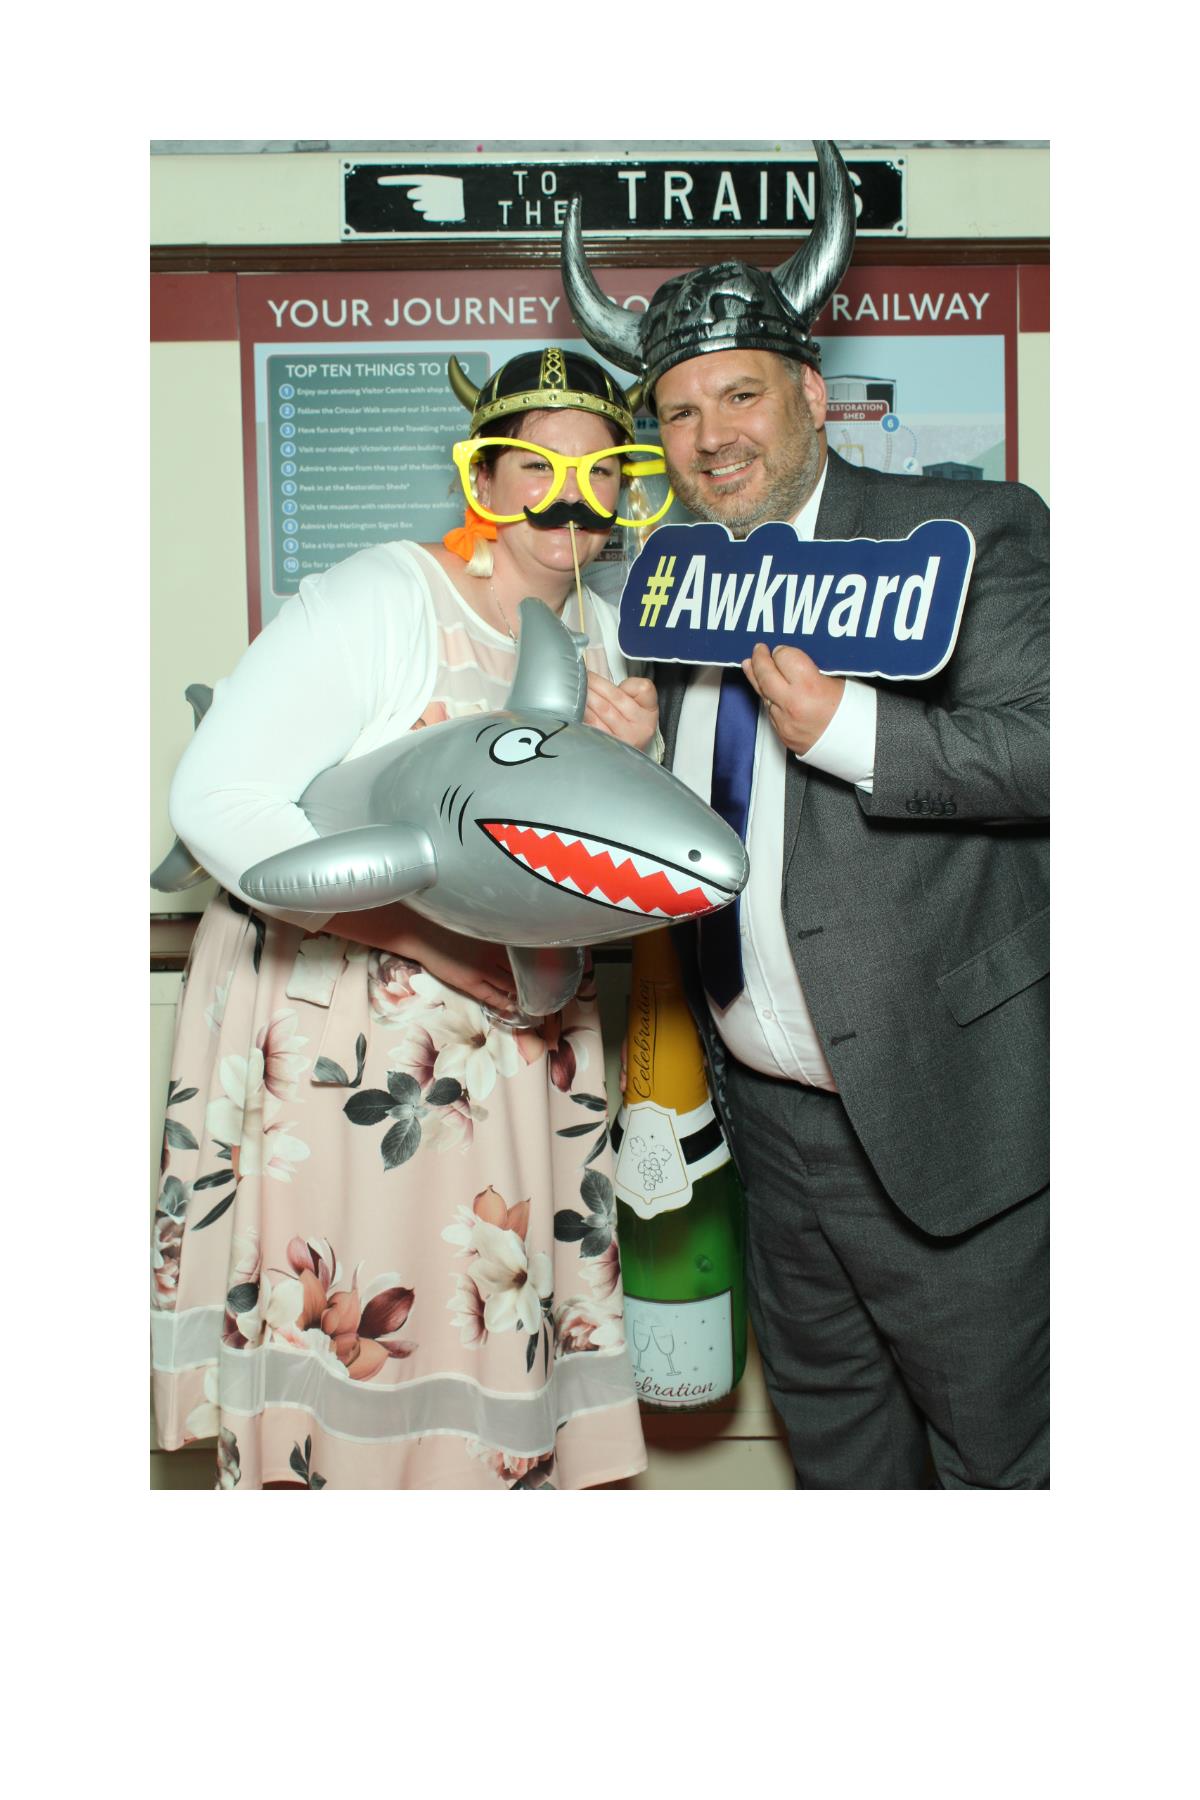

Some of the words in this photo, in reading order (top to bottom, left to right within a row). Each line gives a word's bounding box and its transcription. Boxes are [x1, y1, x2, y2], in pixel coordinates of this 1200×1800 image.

[512, 169, 557, 196] TO
[498, 199, 569, 226] THE
[267, 298, 373, 328] YOUR
[384, 296, 561, 327] JOURNEY
[832, 292, 990, 321] RAILWAY
[285, 364, 318, 378] TOP
[320, 363, 352, 378] TEN
[354, 362, 416, 377] THINGS
[418, 362, 441, 376] TO
[444, 362, 470, 376] O
[297, 388, 316, 396] Enjoy
[330, 388, 360, 396] stunning
[427, 386, 444, 396] shop
[297, 406, 320, 414] Follow
[322, 406, 333, 414] the
[334, 406, 362, 414] Circular
[382, 406, 406, 414] around
[330, 426, 354, 435] sorting
[406, 424, 439, 434] Travelling
[328, 446, 360, 454] nostalgic
[417, 444, 446, 453] building
[386, 464, 398, 472] top
[639, 554, 941, 641] #Awkward
[632, 978, 652, 1099] Celebration
[634, 1373, 716, 1398] ebration
